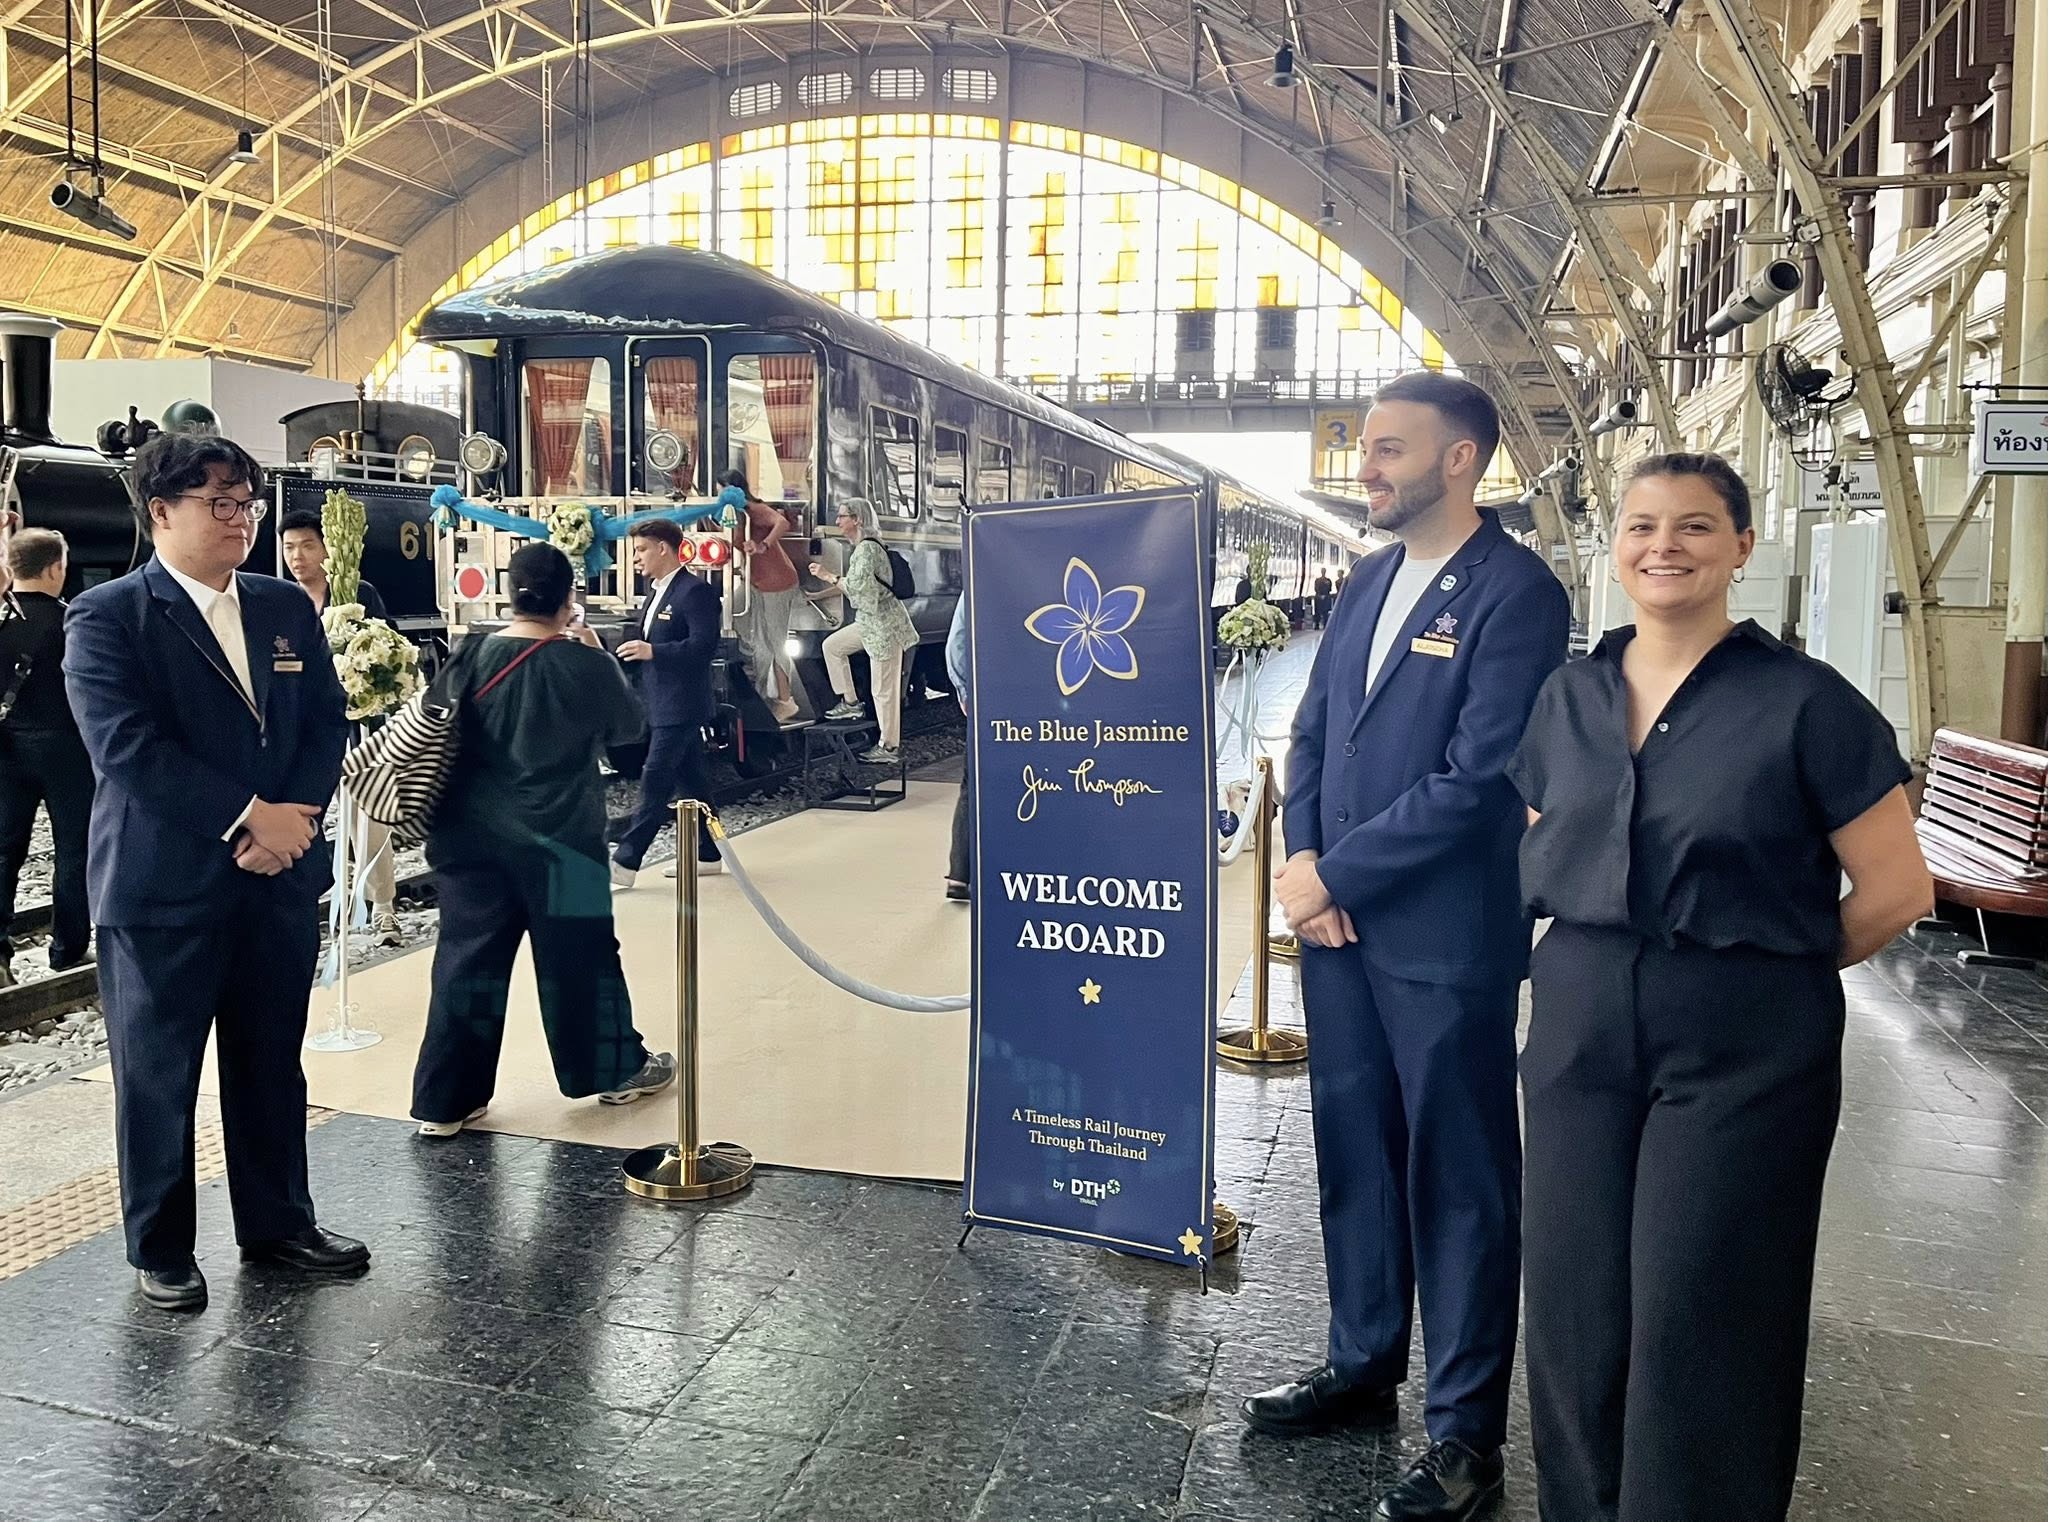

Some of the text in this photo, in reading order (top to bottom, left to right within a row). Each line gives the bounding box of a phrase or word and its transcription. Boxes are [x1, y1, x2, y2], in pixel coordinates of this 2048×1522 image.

[1326, 421, 1348, 449] 3
[991, 719, 1189, 748] The Blue Jasmine
[1017, 758, 1163, 822] Jim Thompson
[1000, 872, 1182, 911] WELCOME
[1016, 919, 1165, 959] ABOARD
[1011, 1108, 1167, 1146] A Timeless Rail Journey
[1028, 1129, 1147, 1161] Through Thailand
[1053, 1178, 1106, 1199] by DTH
